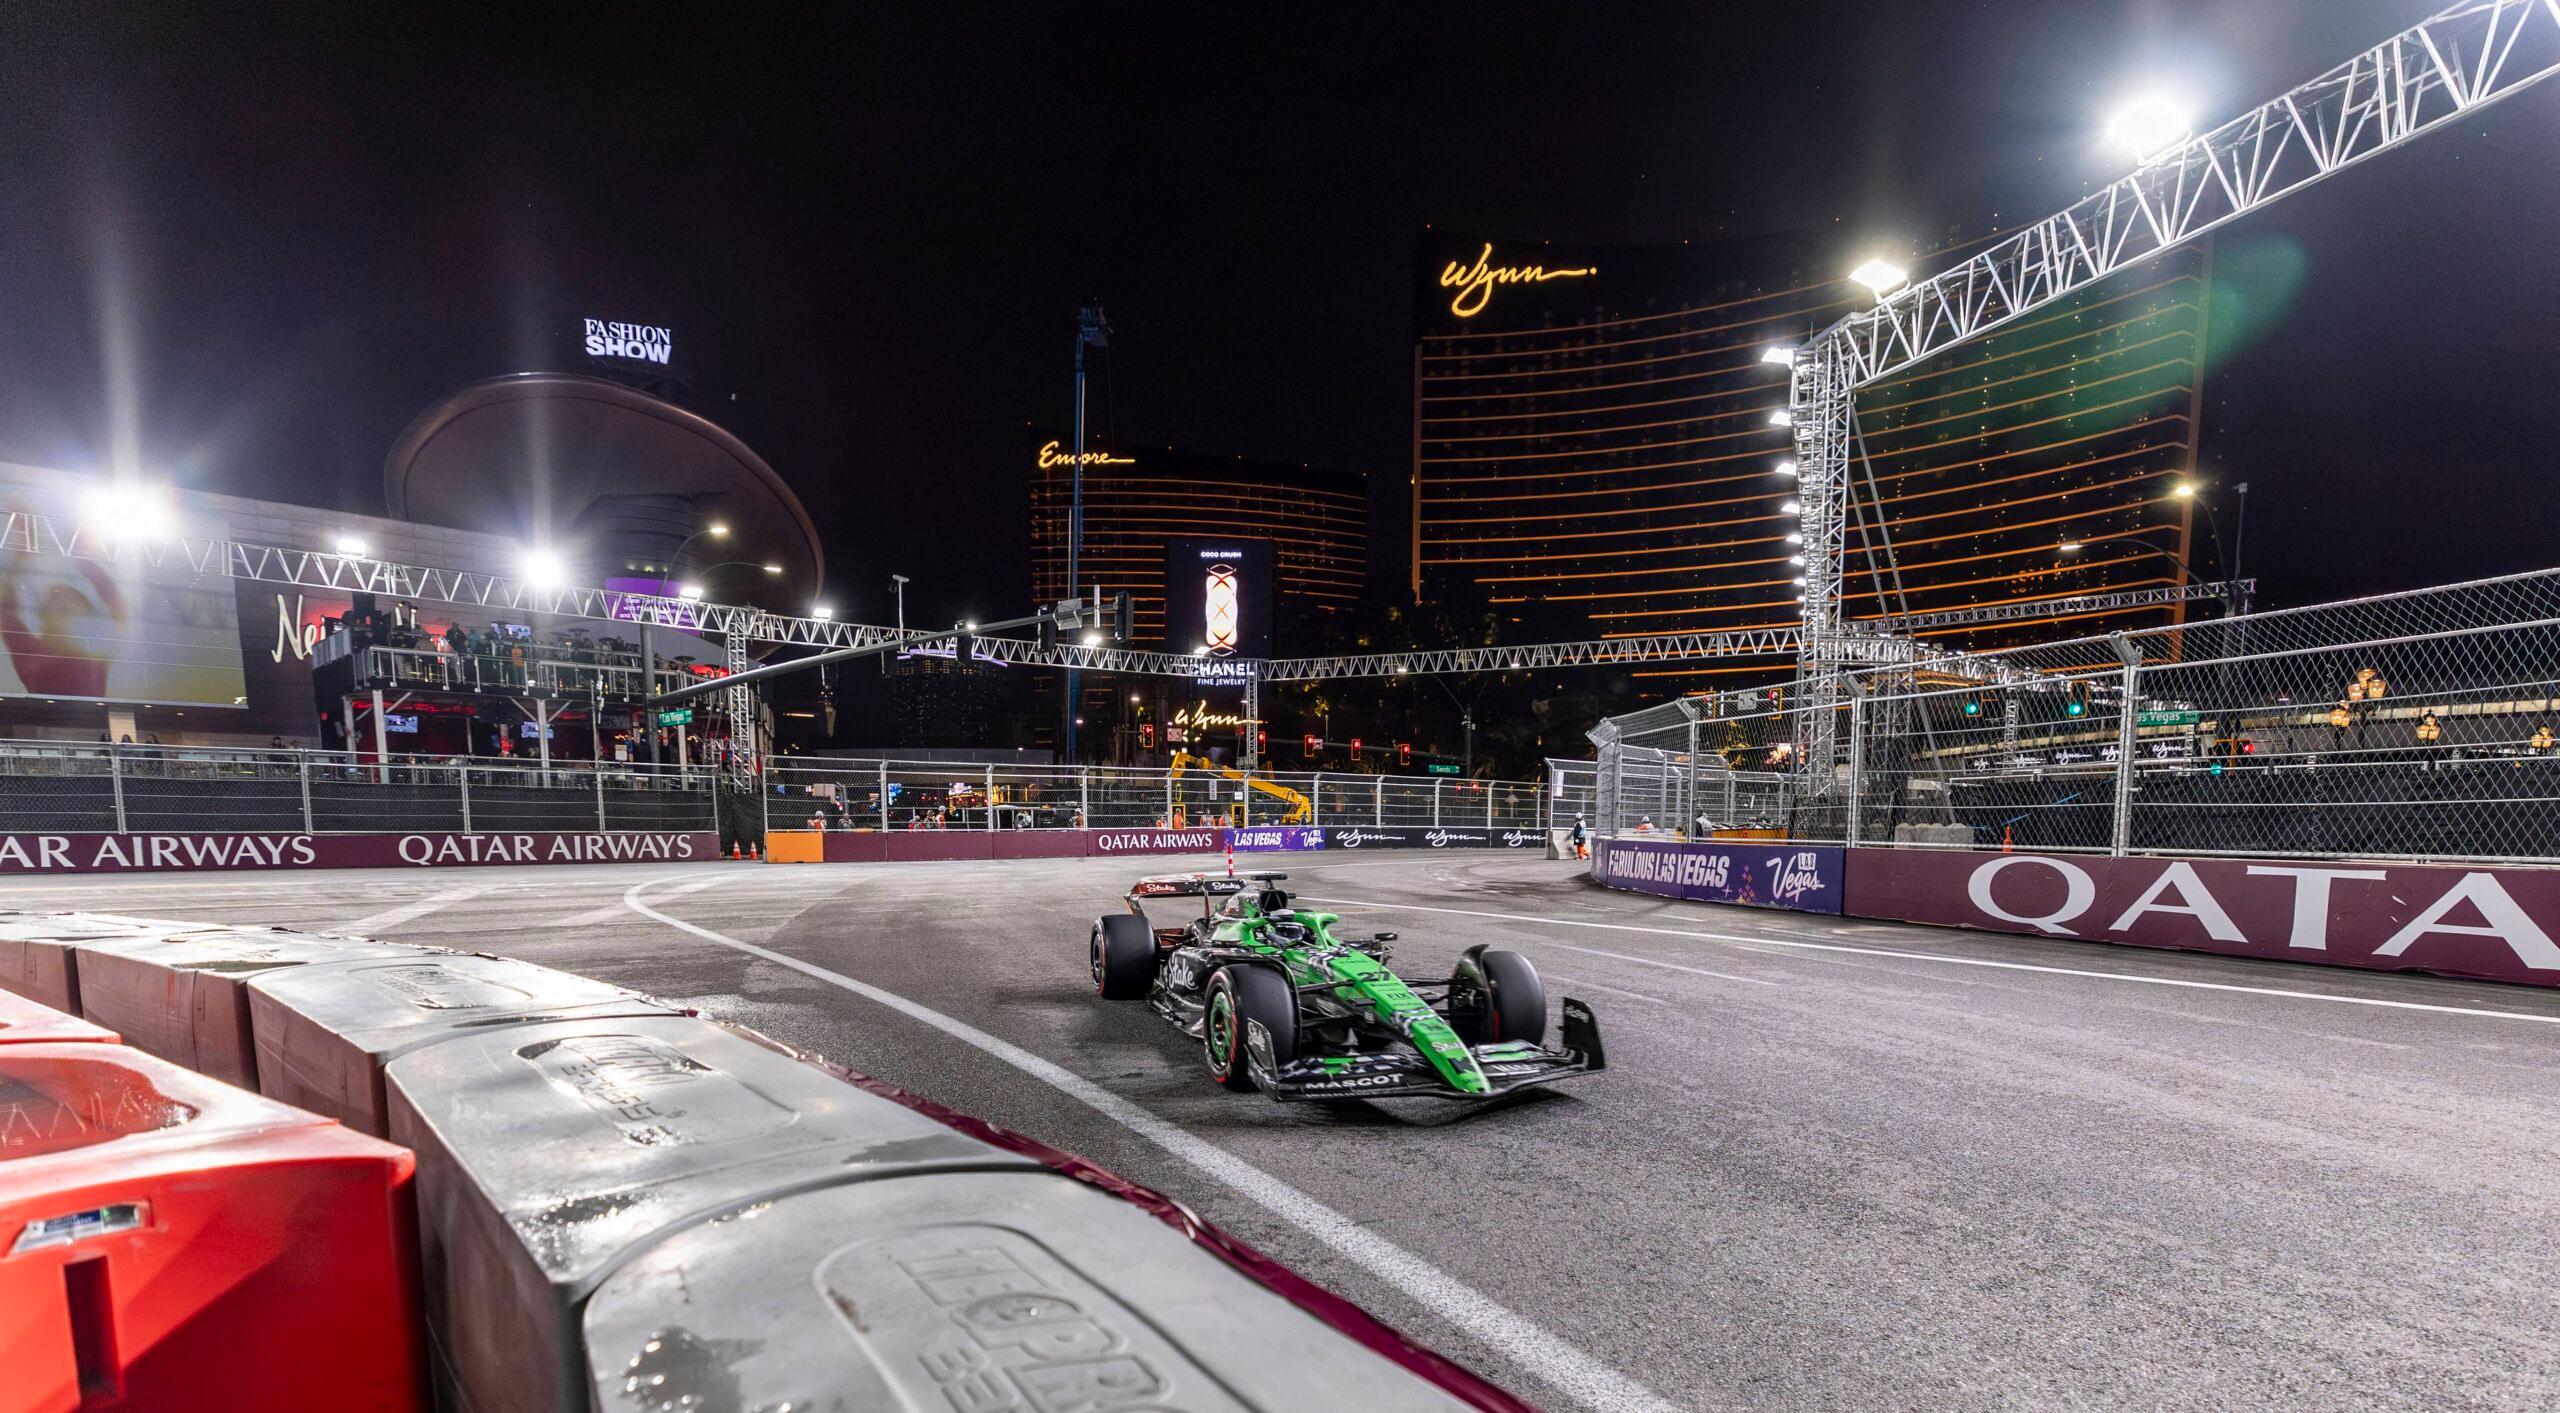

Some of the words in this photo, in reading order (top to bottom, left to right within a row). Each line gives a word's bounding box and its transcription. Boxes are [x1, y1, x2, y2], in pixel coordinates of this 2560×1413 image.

[1440, 242, 1588, 317] Wynn
[584, 318, 671, 345] FASHION
[585, 335, 672, 365] SHOW
[1190, 663, 1255, 676] CHANEL
[1215, 678, 1246, 686] JEWELRY
[662, 713, 671, 723] Las
[671, 711, 685, 724] Vegas
[2150, 711, 2180, 724] Vegas
[1098, 834, 1149, 850] QATAR
[1152, 833, 1212, 848] AIRWAYS
[1234, 832, 1253, 847] LAS
[1253, 832, 1283, 846] VEGAS
[92, 836, 316, 867] AIRWAYS
[398, 835, 539, 866] QATAR
[548, 834, 692, 861] AIRWAYS
[1608, 849, 1655, 880] FABULOUS
[1655, 852, 1676, 884] LAS
[1676, 854, 1730, 889] VEGAS
[1799, 853, 1816, 870] LAS
[1212, 882, 1241, 890] Stake
[1766, 855, 1825, 903] Vegas
[1146, 884, 1176, 892] Stake
[1168, 952, 1199, 990] Stake
[1358, 971, 1390, 982] 27
[1305, 1074, 1404, 1089] MASCOT
